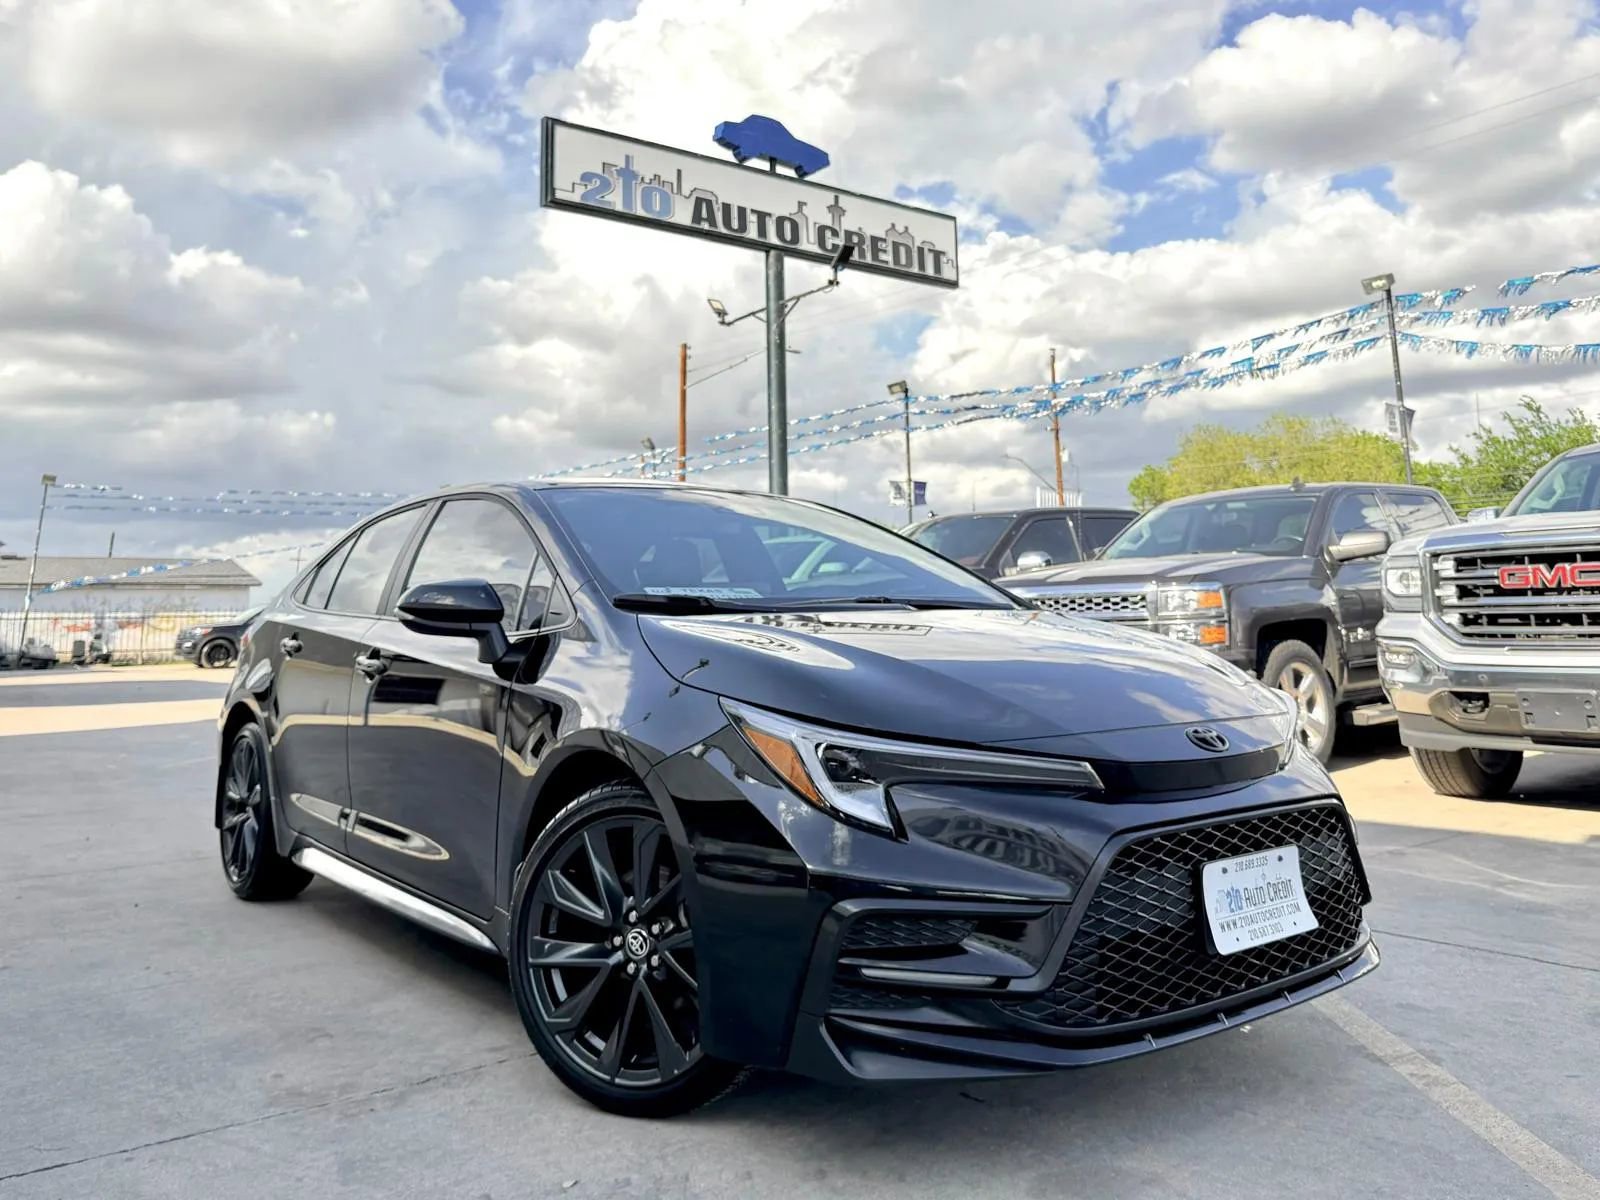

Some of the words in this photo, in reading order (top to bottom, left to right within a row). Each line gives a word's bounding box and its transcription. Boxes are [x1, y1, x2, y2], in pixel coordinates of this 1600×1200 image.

[580, 155, 673, 219] 210
[690, 195, 801, 246] AUTO
[816, 223, 946, 276] CREDIT
[1500, 562, 1600, 589] GMC
[1226, 884, 1244, 914] 210
